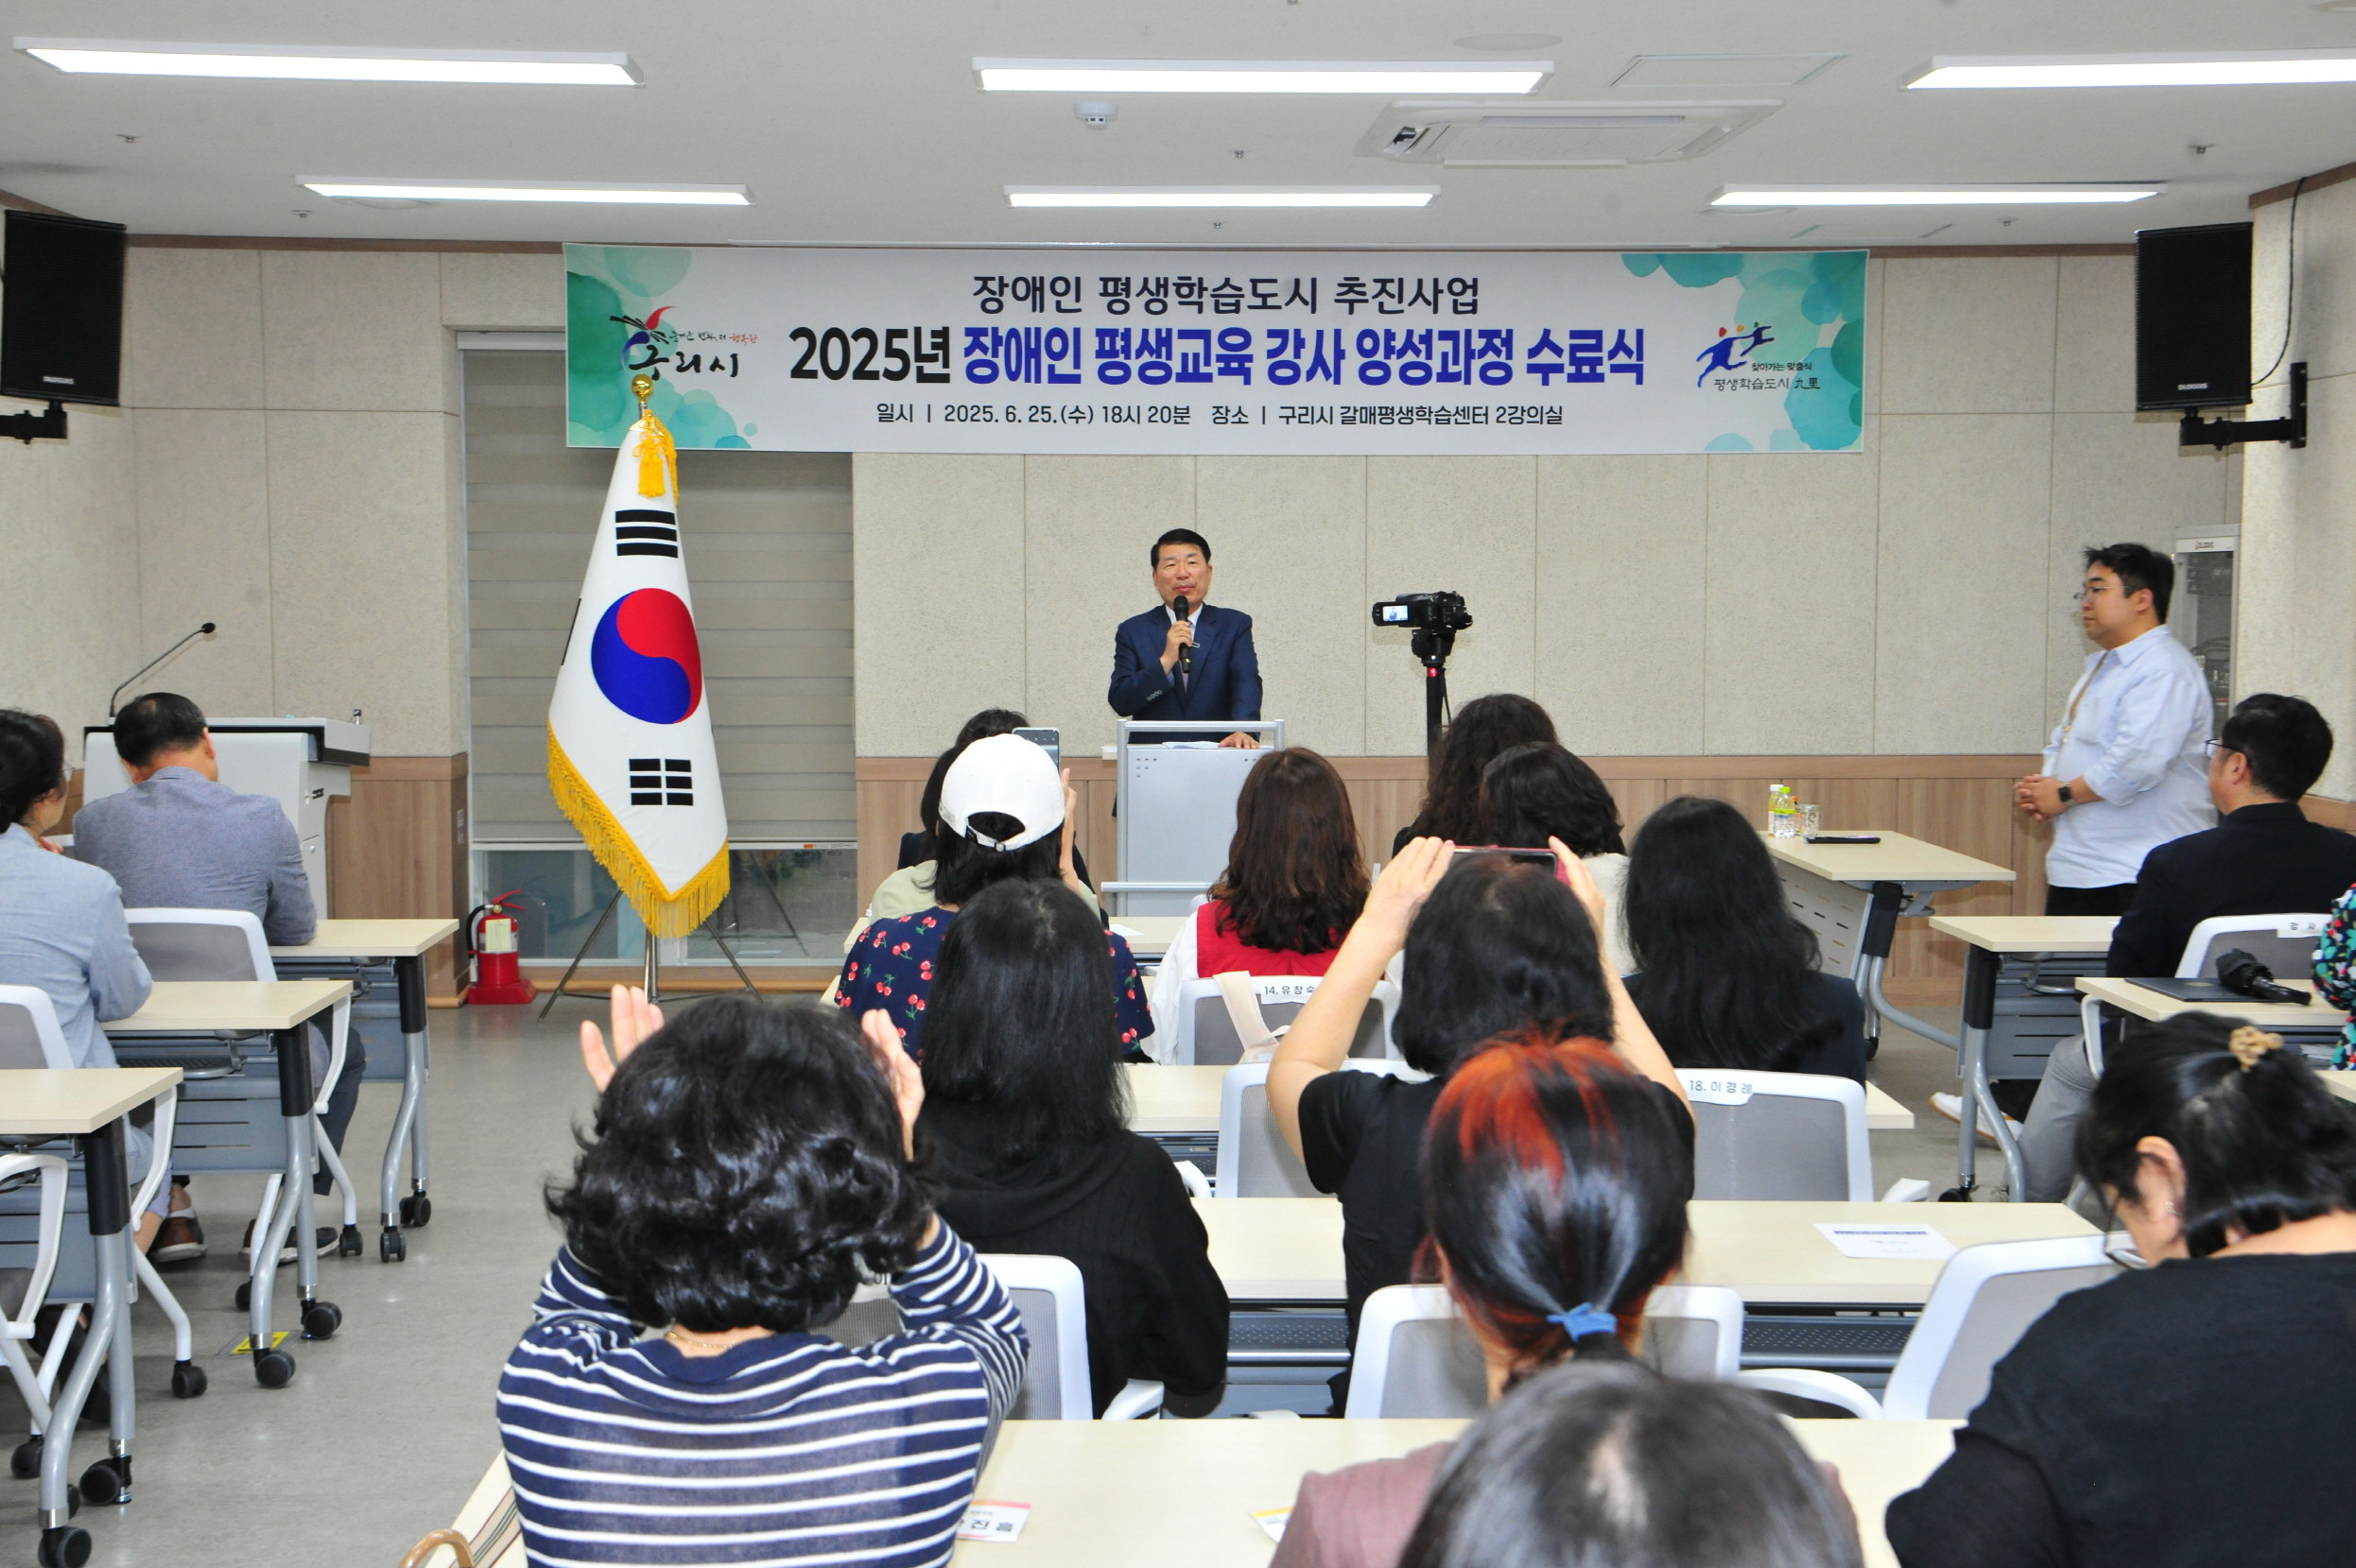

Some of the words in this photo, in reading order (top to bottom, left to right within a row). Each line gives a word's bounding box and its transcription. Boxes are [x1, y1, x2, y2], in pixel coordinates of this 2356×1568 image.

[972, 275, 1083, 315] 장애인
[1099, 275, 1318, 316] 평생학습도시
[1333, 276, 1479, 316] 추진사업
[629, 344, 738, 381] 구리시
[788, 326, 951, 384] 2025년
[963, 326, 1082, 385] 장애인
[1095, 326, 1254, 386] 평생교육
[1266, 328, 1346, 386] 강사
[1356, 328, 1514, 387] 양성과정
[1526, 328, 1644, 387] 수료식
[1752, 362, 1785, 371] 찾아가는
[1714, 378, 1790, 391] 평생학습도시
[876, 403, 913, 423] 일시
[944, 405, 999, 423] 2025.
[1102, 405, 1141, 425] 18시
[1148, 405, 1191, 425] 20분
[1211, 405, 1249, 425] 장소
[1278, 405, 1333, 425] 구리시
[1340, 405, 1489, 425] 갈매평생학습센터
[1496, 405, 1563, 425] 2강의실
